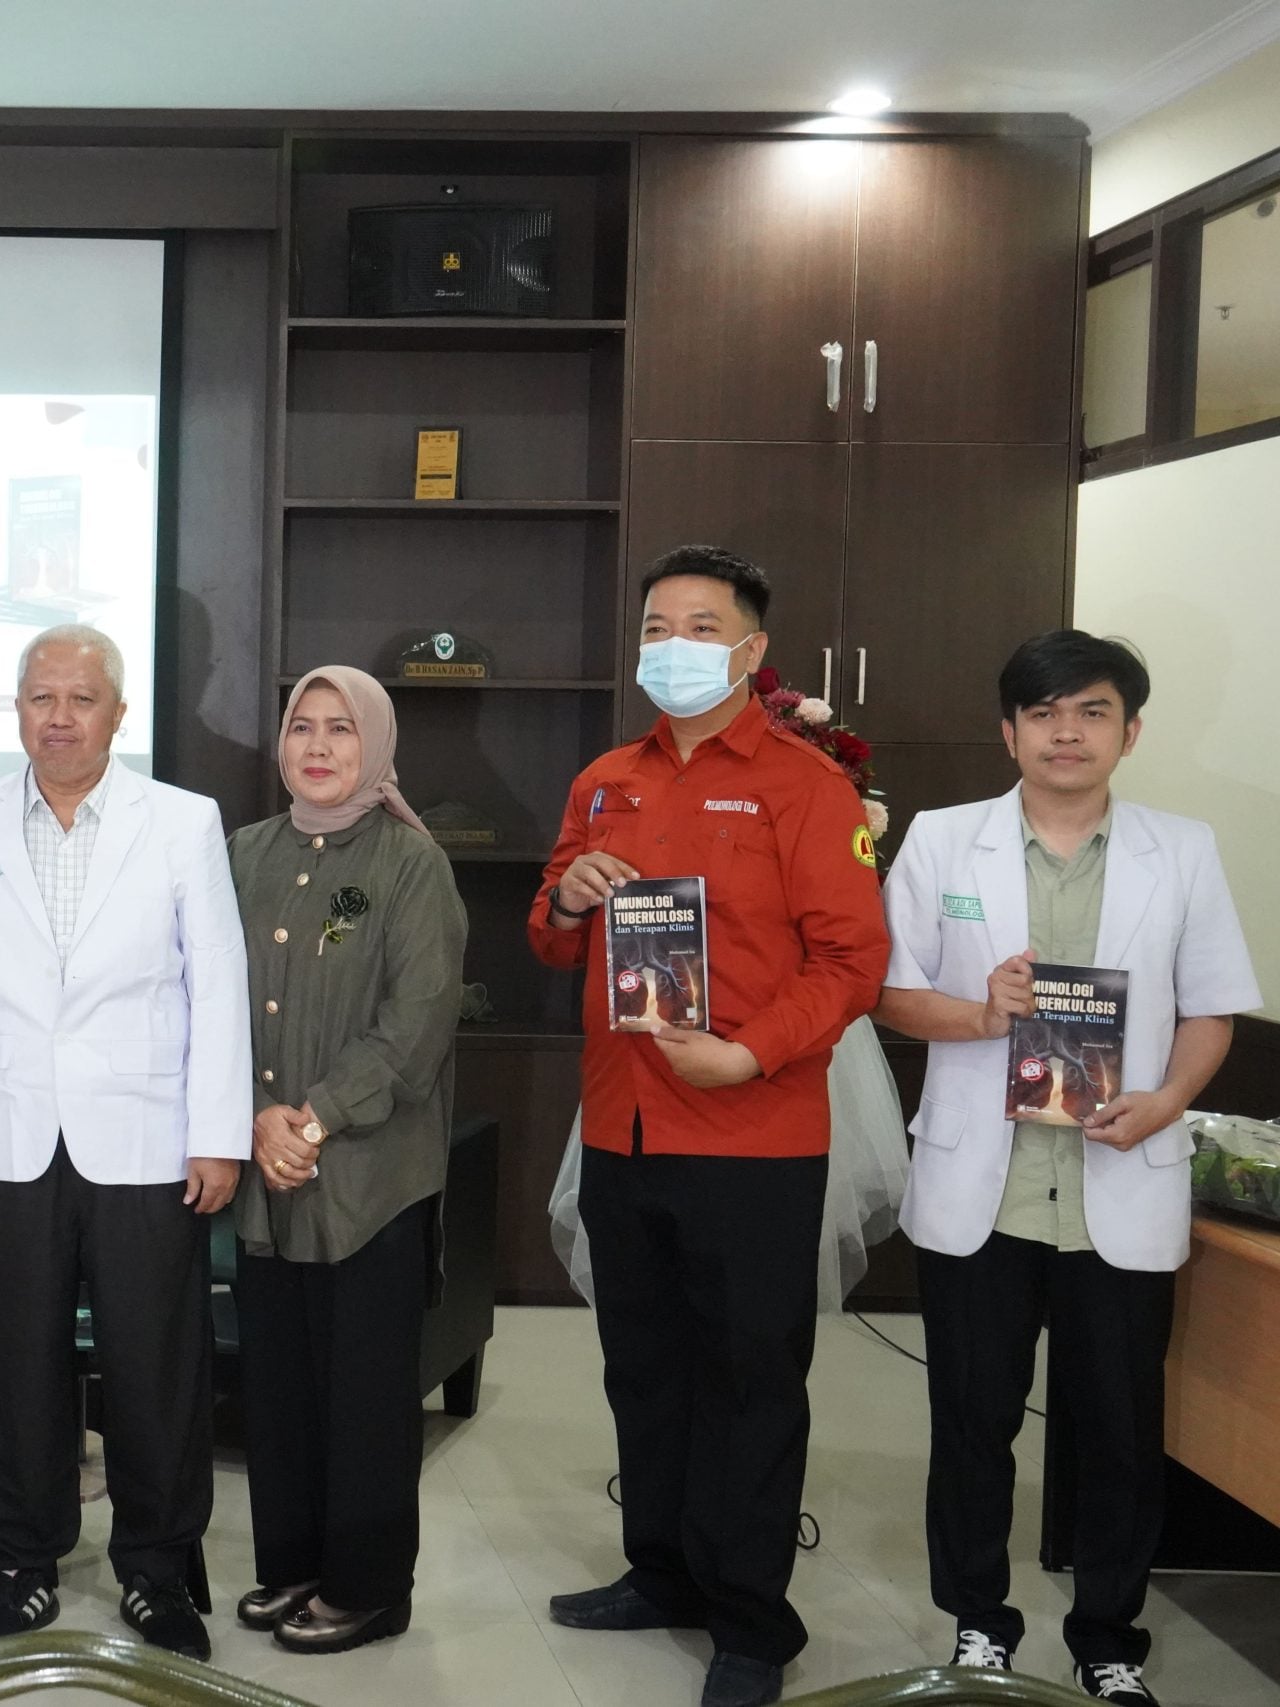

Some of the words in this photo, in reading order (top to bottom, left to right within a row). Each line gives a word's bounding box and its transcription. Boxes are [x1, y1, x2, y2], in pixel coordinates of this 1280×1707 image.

[613, 895, 674, 910] IMUNOLOGI
[614, 909, 695, 925] TUBERKULOSIS
[614, 926, 631, 935] dan
[633, 925, 667, 936] Terapan
[669, 923, 695, 933] Klinis
[1032, 980, 1094, 998] MUNOLOGI
[1042, 1011, 1081, 1023] Terapan
[1085, 1014, 1115, 1025] Klinis
